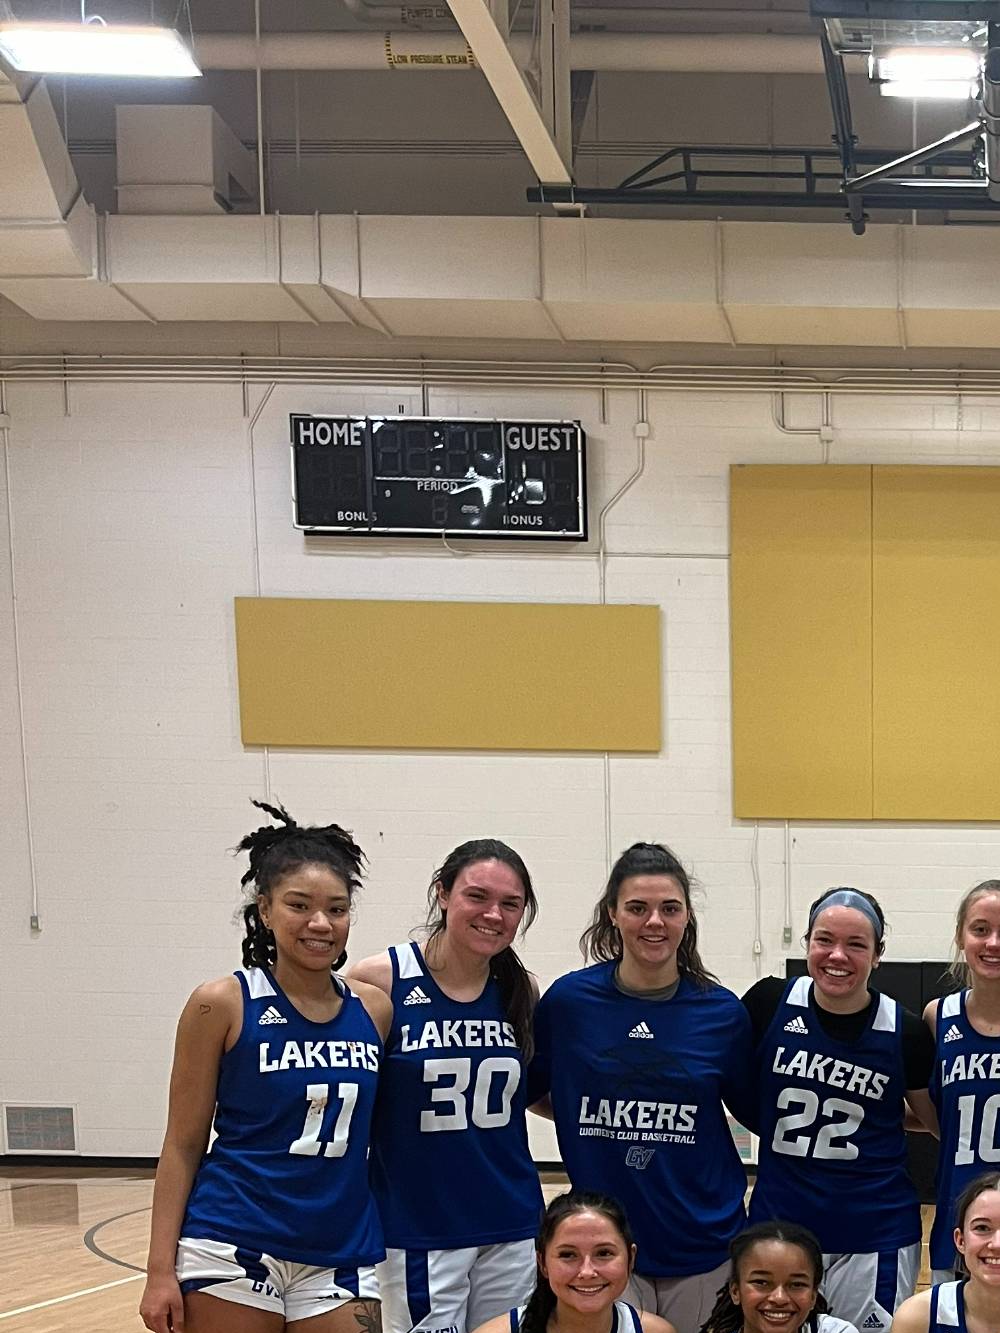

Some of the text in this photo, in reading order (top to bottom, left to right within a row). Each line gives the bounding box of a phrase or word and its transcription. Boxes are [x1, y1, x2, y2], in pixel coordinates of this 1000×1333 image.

[392, 54, 468, 64] LOW PRESSURE STEAM
[300, 421, 362, 446] HOME
[505, 427, 574, 451] GUEST
[417, 481, 459, 492] PERIOD
[403, 997, 432, 1006] adidas
[258, 1016, 288, 1026] adidas
[783, 1024, 809, 1035] adidas
[401, 1020, 519, 1053] LAKERS
[628, 1031, 655, 1039] adidas
[259, 1041, 380, 1073] LAKERS
[772, 1046, 890, 1100] LAKERS
[420, 1056, 522, 1133] 30
[288, 1082, 359, 1158] 11
[578, 1096, 698, 1133] LAKERS
[771, 1087, 866, 1161] 22
[579, 1127, 696, 1145] WOMEN'S CLUB BASKETBALL
